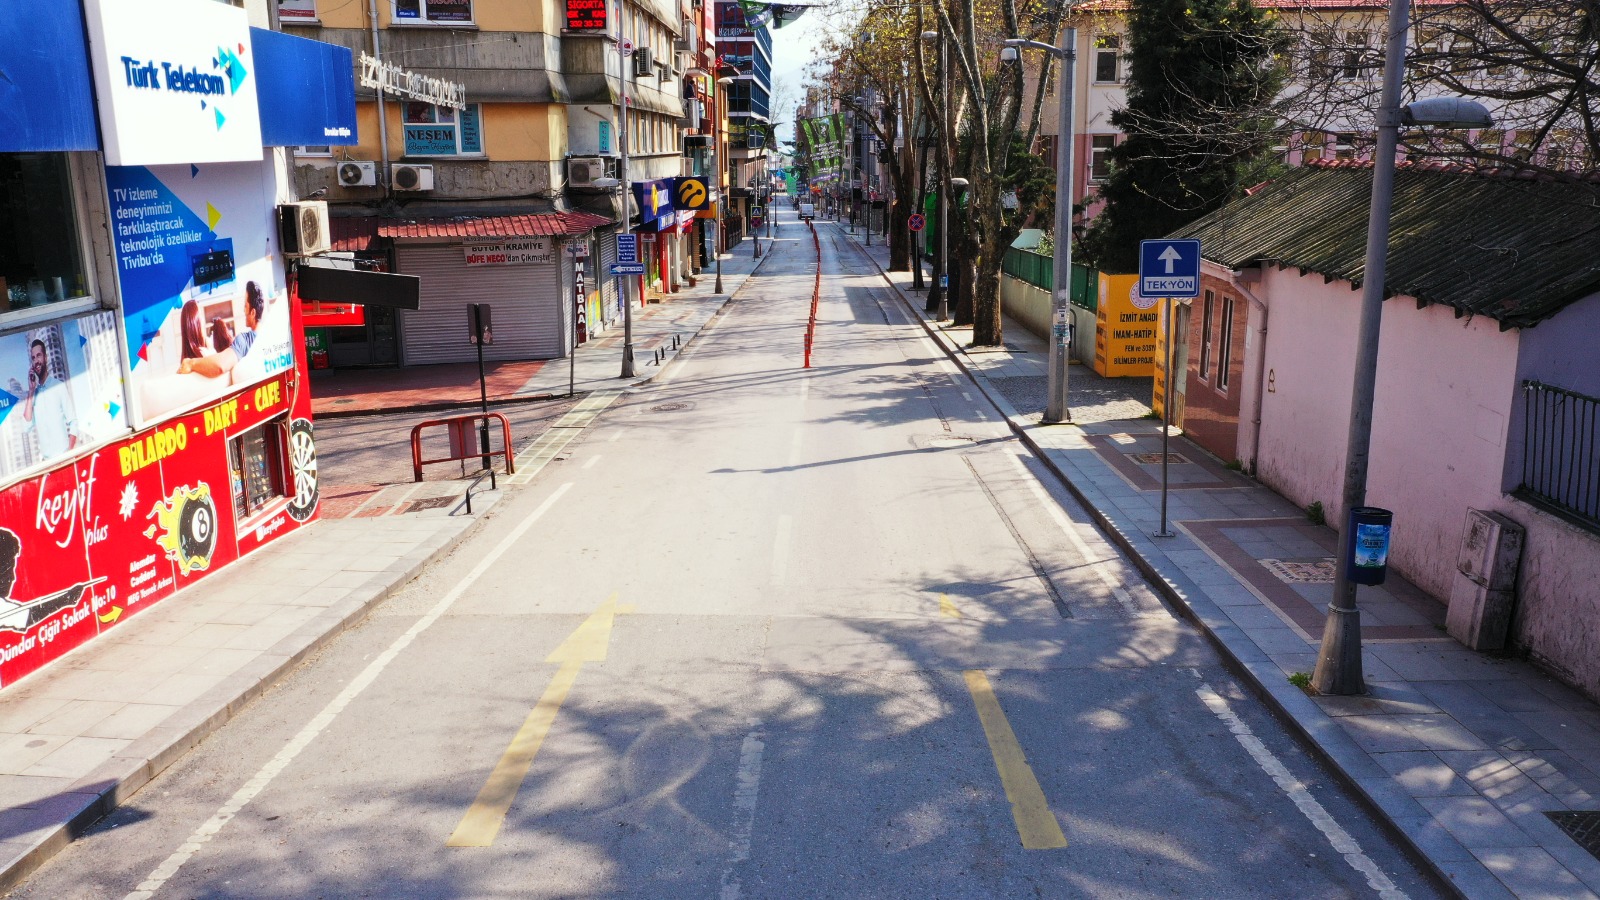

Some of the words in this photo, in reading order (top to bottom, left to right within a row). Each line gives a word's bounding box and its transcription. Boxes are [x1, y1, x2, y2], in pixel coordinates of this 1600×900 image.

[121, 56, 160, 90] Türk
[161, 61, 226, 96] Telekom
[407, 130, 452, 143] NEŞEM
[114, 188, 127, 202] TV
[128, 187, 158, 201] izleme
[116, 201, 173, 220] deneyiminizi
[118, 216, 184, 237] farklılaştıracak
[120, 234, 165, 254] teknolojik
[166, 230, 202, 246] özellikler
[503, 241, 543, 251] İKRAMİYE
[122, 252, 164, 270] Tivibu'da
[466, 253, 486, 264] BÜFE
[575, 262, 586, 324] MATBAA
[1146, 281, 1167, 290] TEK
[1170, 278, 1193, 289] YÖN
[1119, 311, 1138, 323] İZMİT
[1113, 328, 1152, 339] İMAM-HATİP
[118, 422, 187, 477] BİLARDO
[203, 398, 238, 436] DART
[254, 380, 281, 412] CAFE
[36, 452, 100, 548] keyif
[86, 515, 109, 546] plus
[0, 635, 36, 665] Dündar
[38, 619, 61, 648] Çiğit
[62, 601, 90, 631] Sokak
[91, 585, 116, 612] No:10
